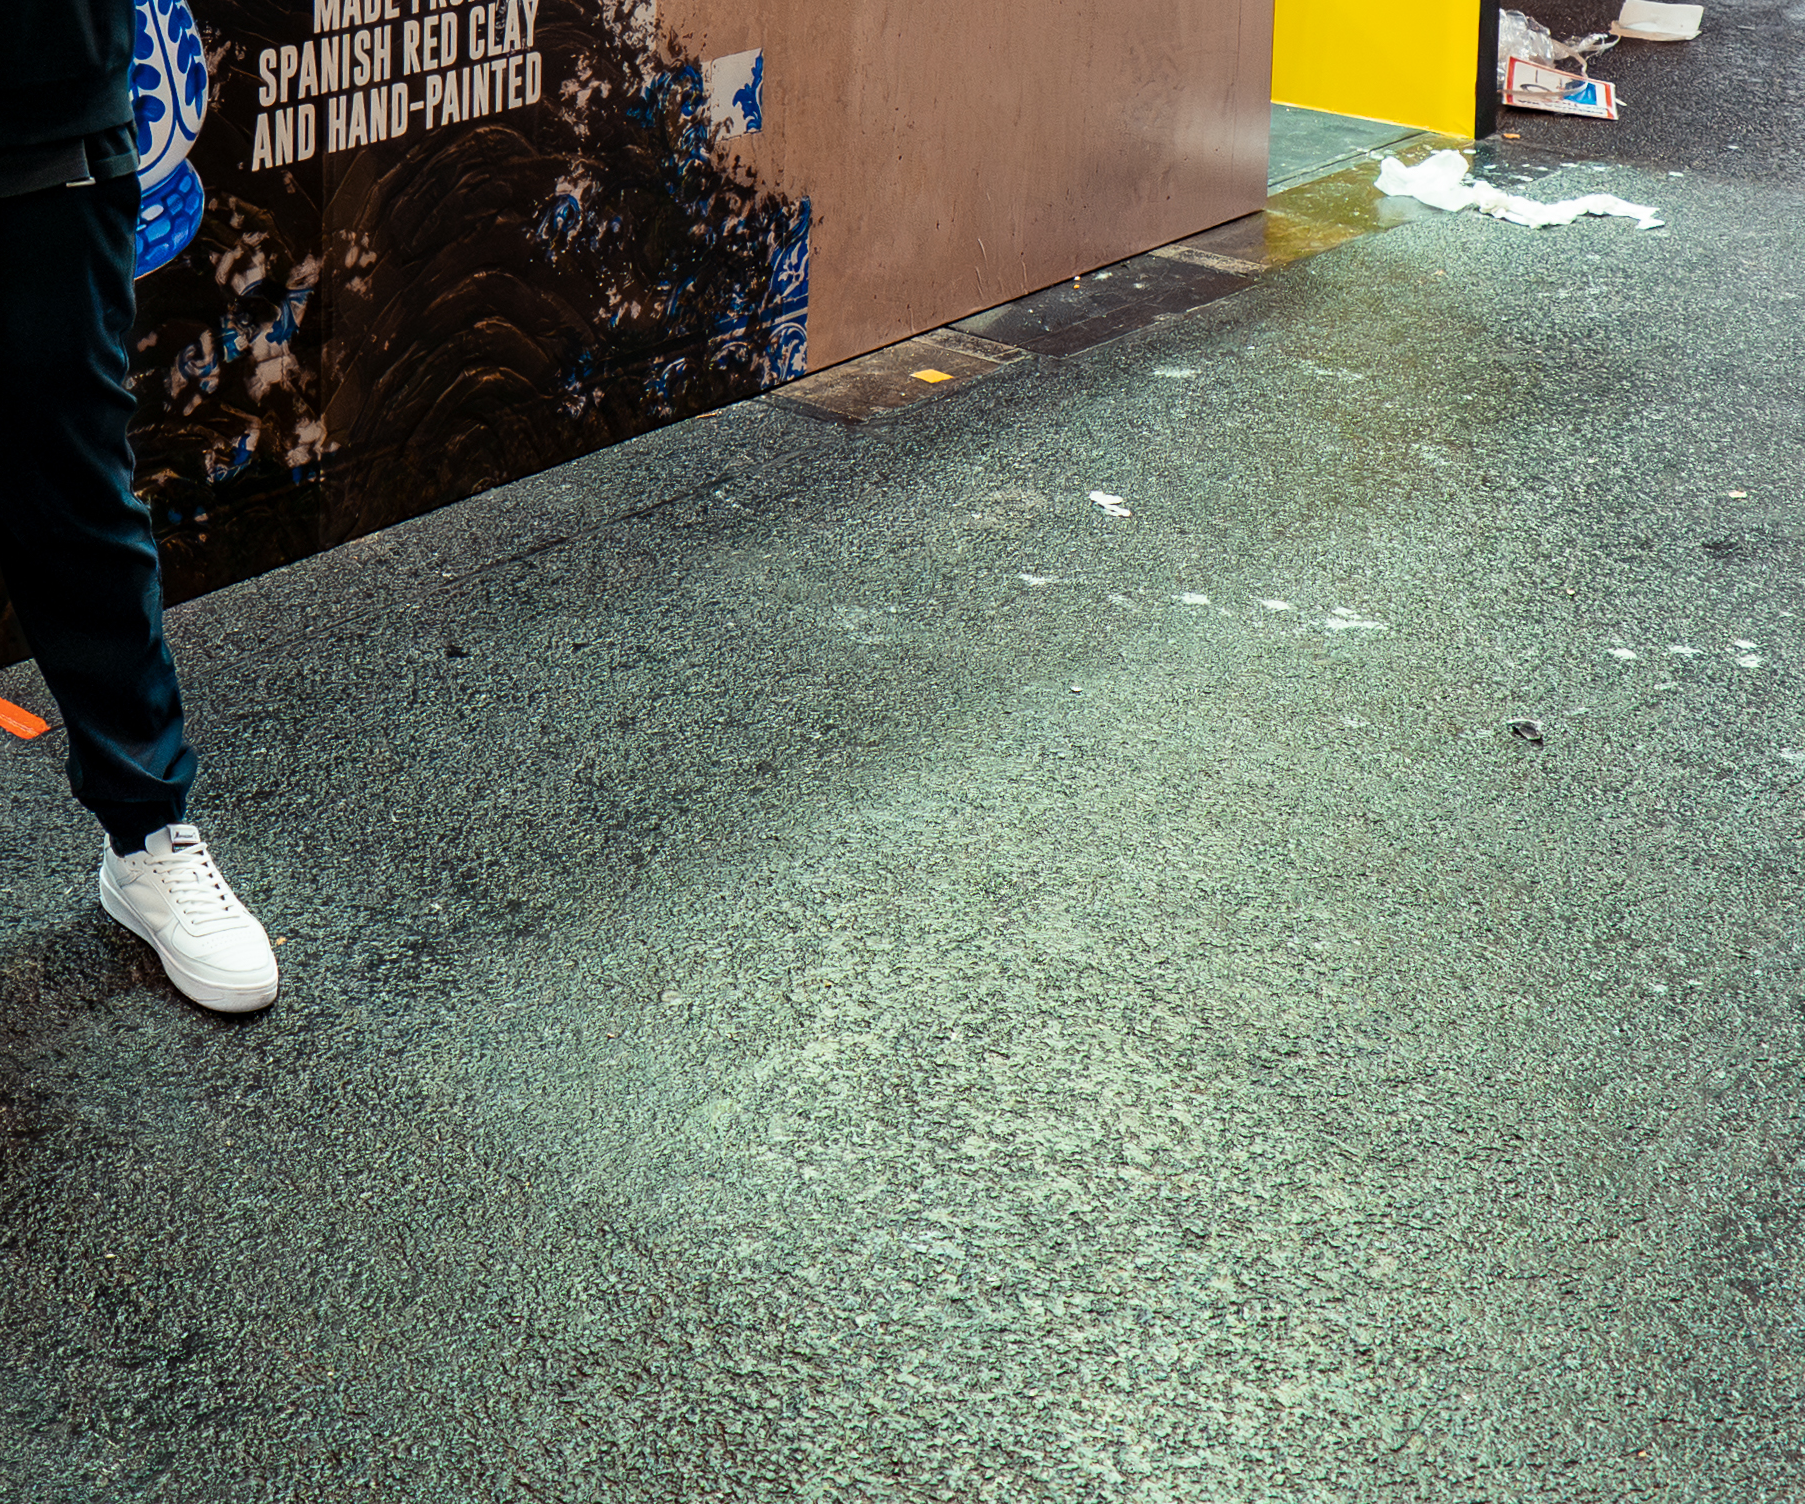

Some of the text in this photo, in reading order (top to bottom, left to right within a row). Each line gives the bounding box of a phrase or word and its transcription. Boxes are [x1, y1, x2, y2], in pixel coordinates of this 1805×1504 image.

[251, 51, 542, 172] AND HAND-PAINTED
[258, 25, 392, 108] SPANISH
[403, 11, 458, 76] RED
